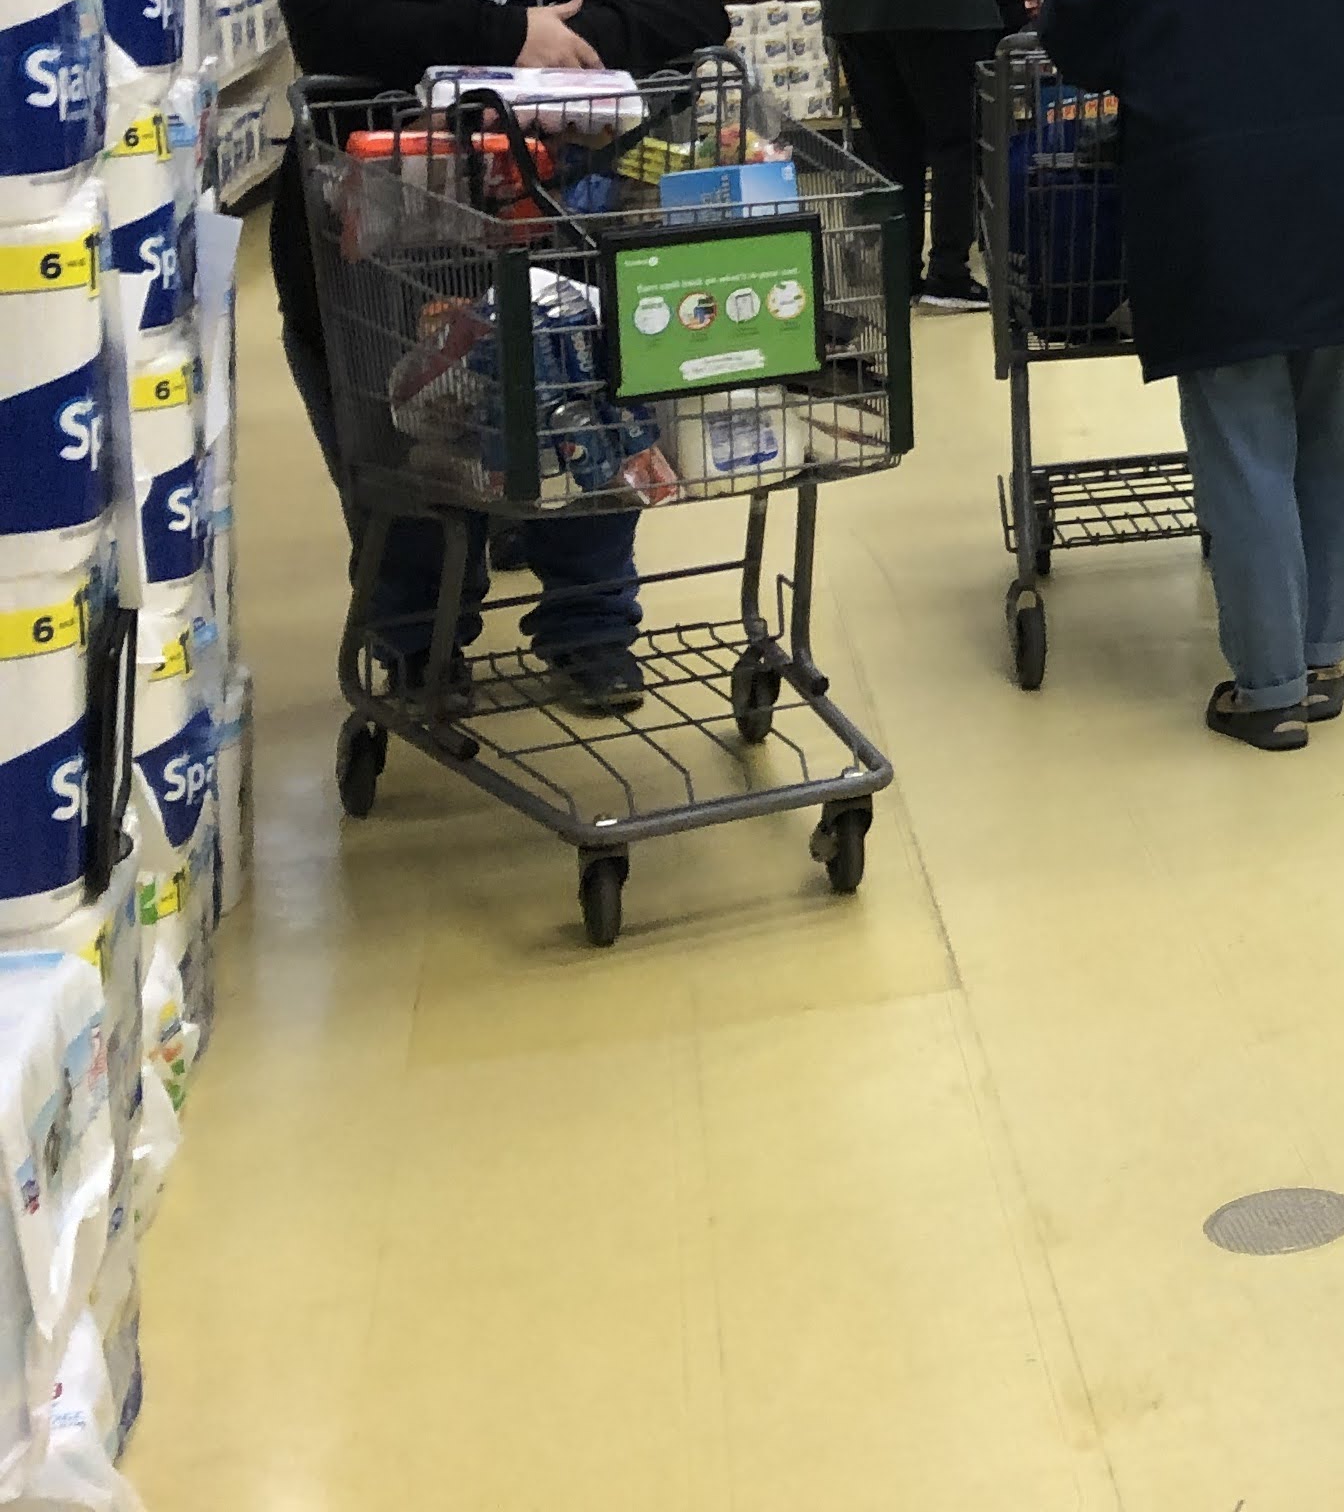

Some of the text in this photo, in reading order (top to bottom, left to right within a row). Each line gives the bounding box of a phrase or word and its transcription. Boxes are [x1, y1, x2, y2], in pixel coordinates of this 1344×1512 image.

[125, 126, 140, 147] 6
[40, 253, 62, 280] 6
[155, 380, 171, 400] 6
[32, 617, 54, 642] 6
